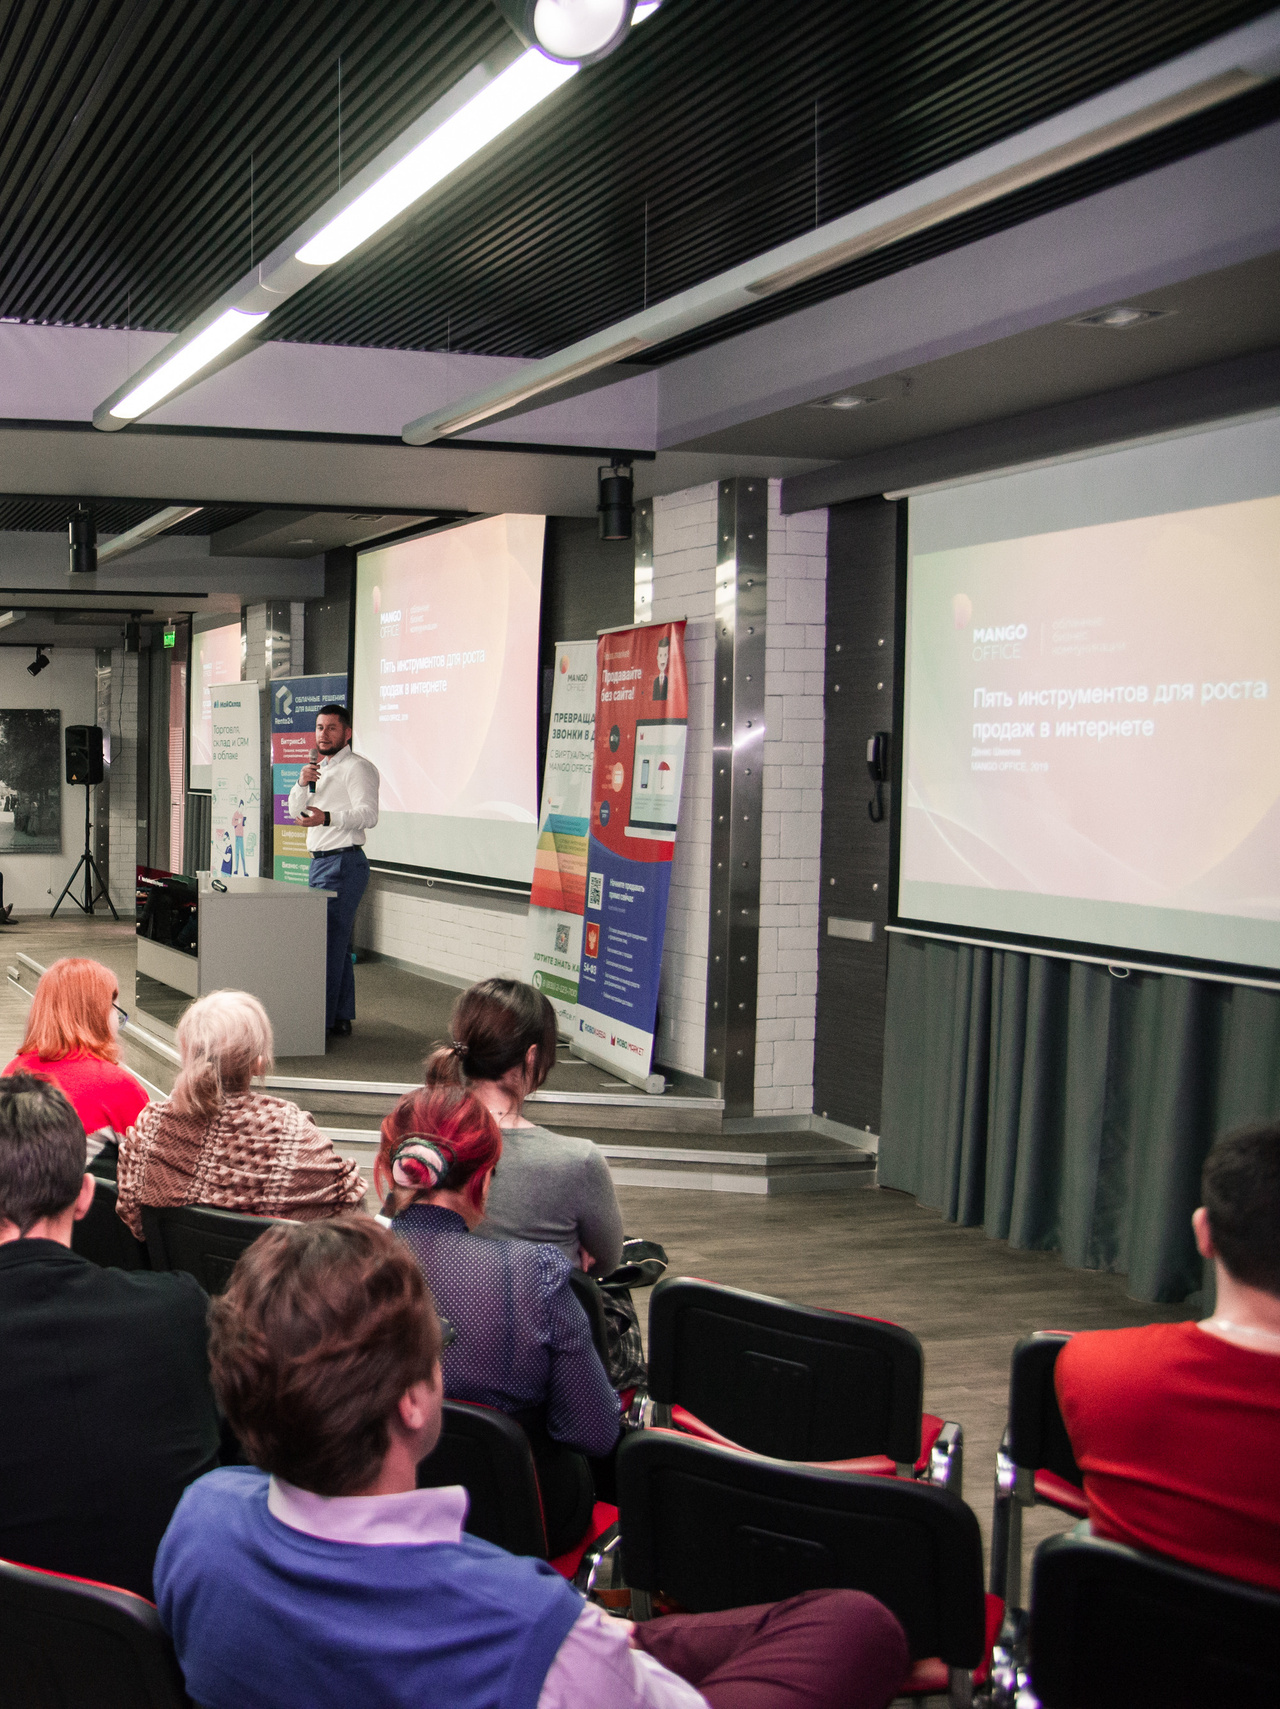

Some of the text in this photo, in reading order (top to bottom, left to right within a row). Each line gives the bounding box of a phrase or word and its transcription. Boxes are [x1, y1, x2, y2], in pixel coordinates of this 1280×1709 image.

[380, 610, 402, 625] MANGO
[380, 624, 400, 638] OFFICE
[972, 623, 1028, 643] MANGO
[972, 642, 1022, 662] OFFICE
[380, 649, 485, 674] Пять инструментов для роста
[567, 673, 588, 682] MANGO
[601, 666, 642, 685] Продавайте
[380, 683, 404, 700] продаж
[410, 679, 448, 697] интернете
[566, 683, 585, 691] OFFICE
[601, 686, 635, 702] без сайта!
[972, 680, 1268, 710] Пять инструментов для роста
[552, 728, 582, 741] ЗВОНКИ
[584, 730, 589, 741] В
[972, 718, 1155, 743] продаж в интернете
[213, 737, 231, 747] склад
[237, 737, 249, 746] CRM
[218, 750, 238, 761] облаке
[549, 762, 592, 773] MANGO OFFICE
[533, 951, 554, 966] ХОТИТЕ
[554, 958, 571, 971] ЗНАТЬ
